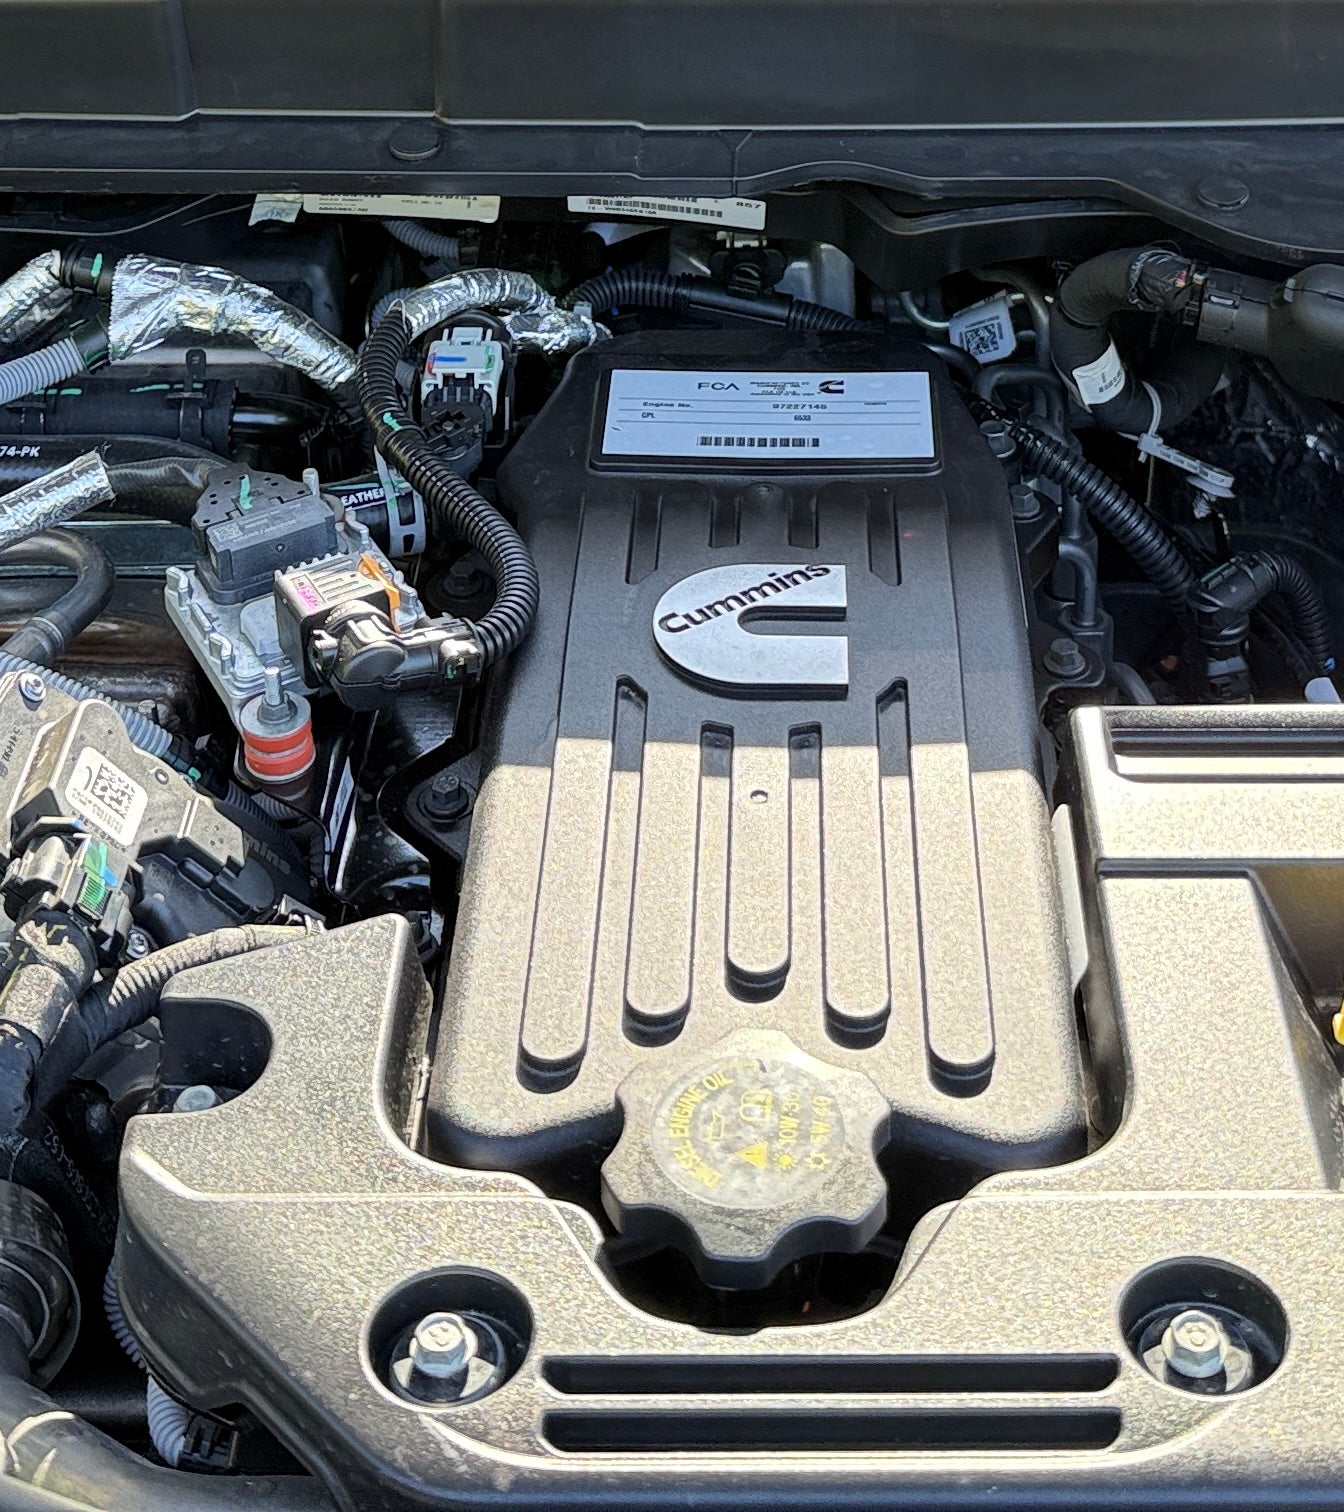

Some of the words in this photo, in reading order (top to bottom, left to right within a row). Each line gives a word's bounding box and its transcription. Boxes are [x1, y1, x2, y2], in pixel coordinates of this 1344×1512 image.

[697, 382, 740, 391] FCA
[658, 563, 831, 633] Cummins
[669, 1084, 709, 1139] ENGINE
[702, 1071, 734, 1092] OIL
